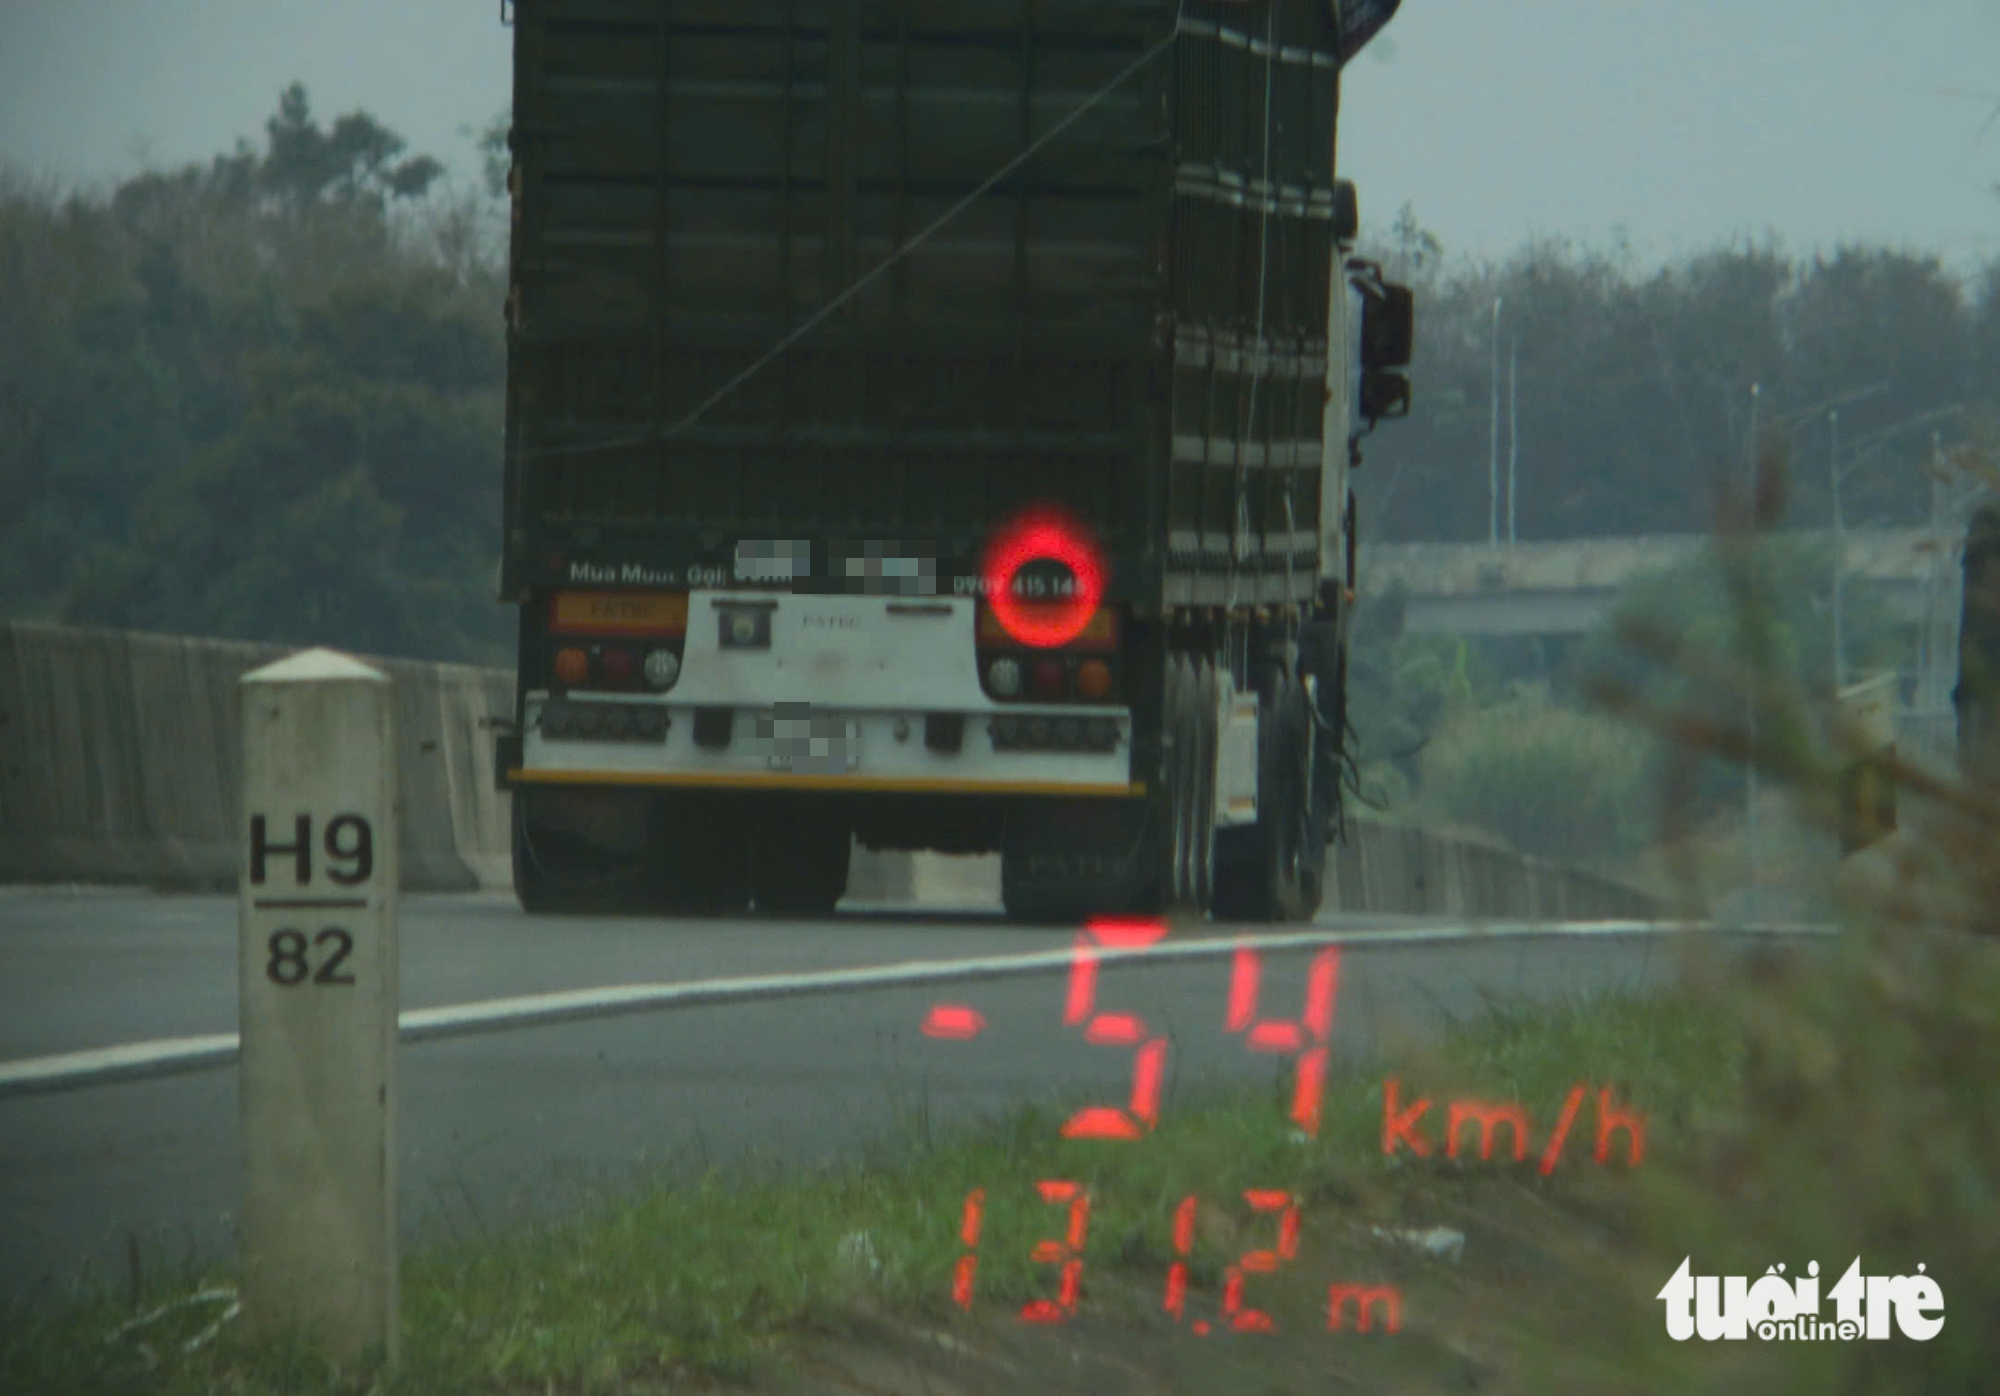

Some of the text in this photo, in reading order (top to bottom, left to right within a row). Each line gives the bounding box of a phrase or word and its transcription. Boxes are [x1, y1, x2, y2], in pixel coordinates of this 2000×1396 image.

[250, 813, 373, 886] H9
[266, 927, 355, 985] 82
[1381, 1078, 1646, 1177] km/h
[1328, 1282, 1402, 1333] m
